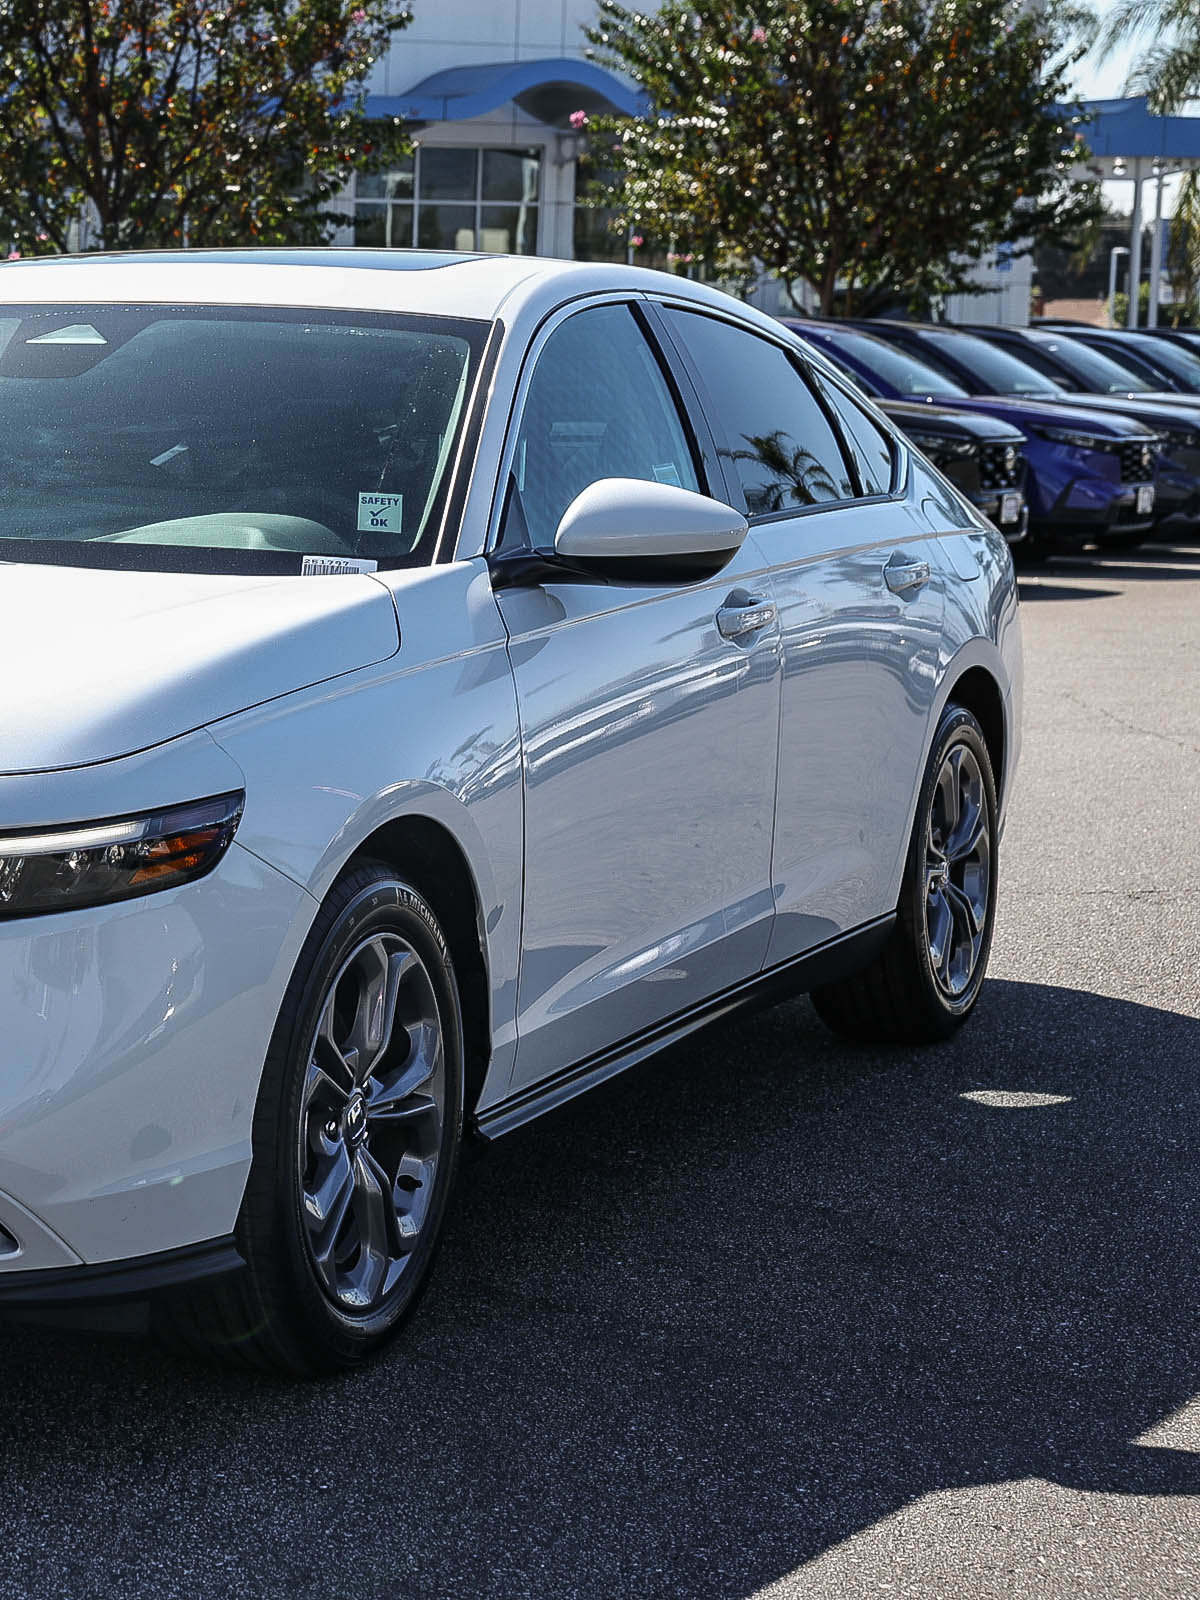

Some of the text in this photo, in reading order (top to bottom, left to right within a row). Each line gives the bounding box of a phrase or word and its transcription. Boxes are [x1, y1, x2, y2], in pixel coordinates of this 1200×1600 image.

[360, 496, 400, 506] SAFETY
[370, 518, 388, 527] OK
[409, 894, 445, 949] MICHELIN
